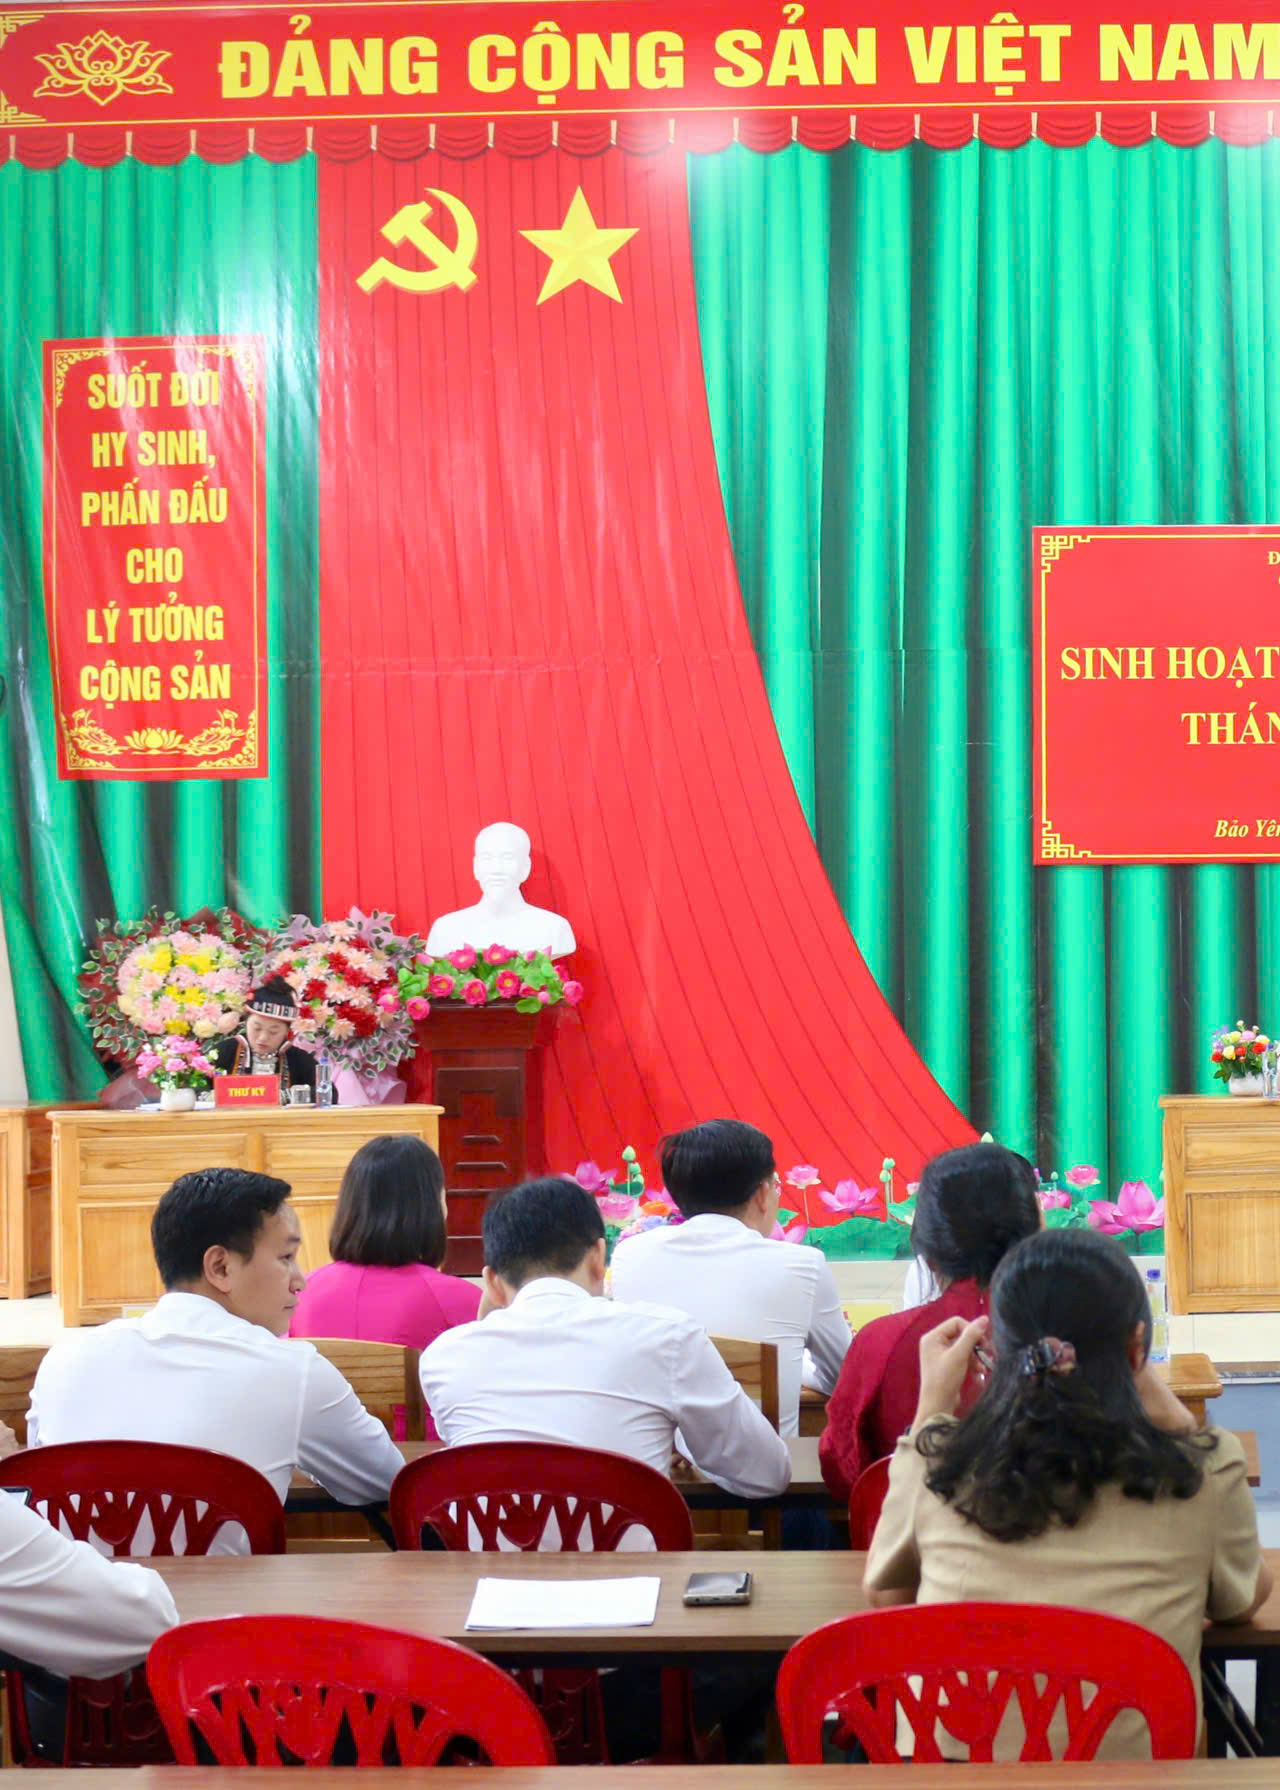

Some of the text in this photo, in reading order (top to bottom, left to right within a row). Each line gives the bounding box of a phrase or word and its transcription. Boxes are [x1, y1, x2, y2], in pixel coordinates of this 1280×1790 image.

[218, 15, 440, 99] ĐẢNG
[467, 20, 688, 104] CỘNG
[715, 2, 878, 88] SẢN
[904, 10, 1072, 96] VIỆT
[87, 360, 162, 409] SUỐT
[91, 428, 216, 469] HY SINH,
[80, 476, 229, 527] PHẤN ĐẤU
[126, 545, 184, 584] CHO
[87, 592, 224, 645] LÝ TƯỞNG
[78, 650, 232, 711] CỘNG SẢN
[1061, 648, 1154, 680] SINH
[1168, 646, 1280, 688] HOẠT
[1214, 818, 1250, 838] Bảo
